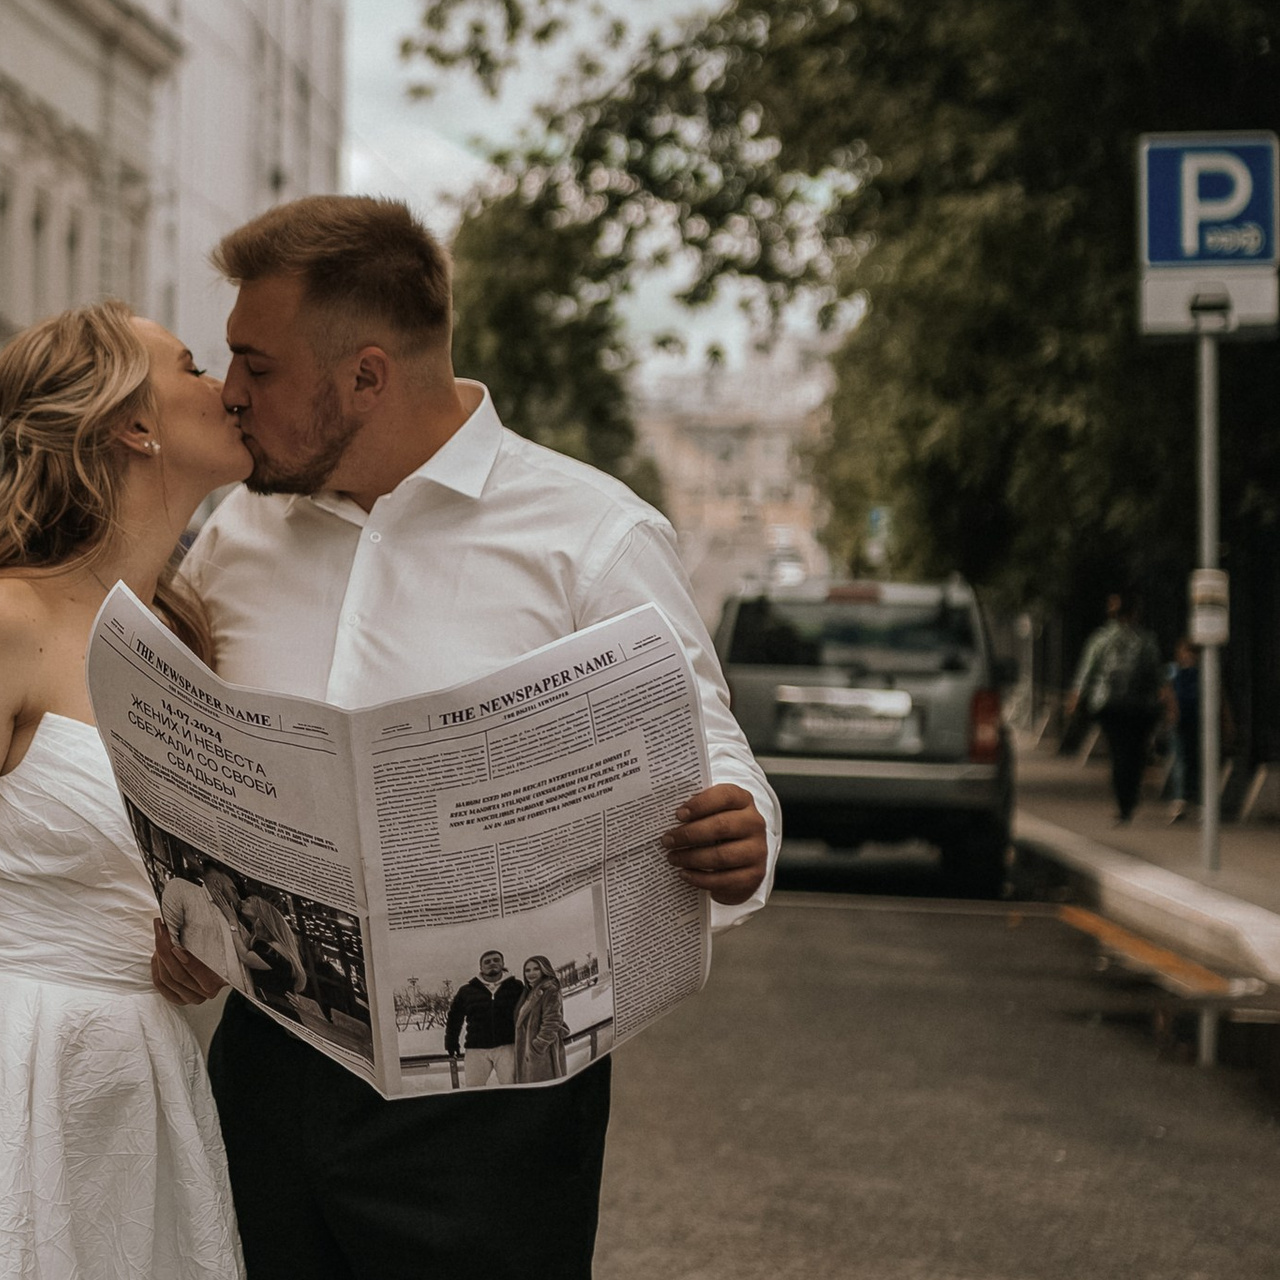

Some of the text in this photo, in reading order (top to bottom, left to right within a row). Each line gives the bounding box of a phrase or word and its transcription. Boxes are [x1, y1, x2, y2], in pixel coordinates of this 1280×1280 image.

[1181, 151, 1252, 258] P
[136, 639, 272, 726] THE NEWSPAPER NAME
[161, 699, 222, 743] 14.07.2024
[438, 706, 476, 726] THE
[479, 671, 572, 716] NEWSPAPER
[573, 650, 618, 678] NAME
[128, 710, 195, 760] СБЕЖАЛИ
[197, 752, 219, 772] СО
[221, 765, 278, 798] СВОЕЙ
[131, 693, 179, 735] ЖЕНИХ
[182, 726, 193, 742] И
[194, 733, 267, 777] НЕВЕСТА
[167, 751, 237, 798] СВАДЬБЫ
